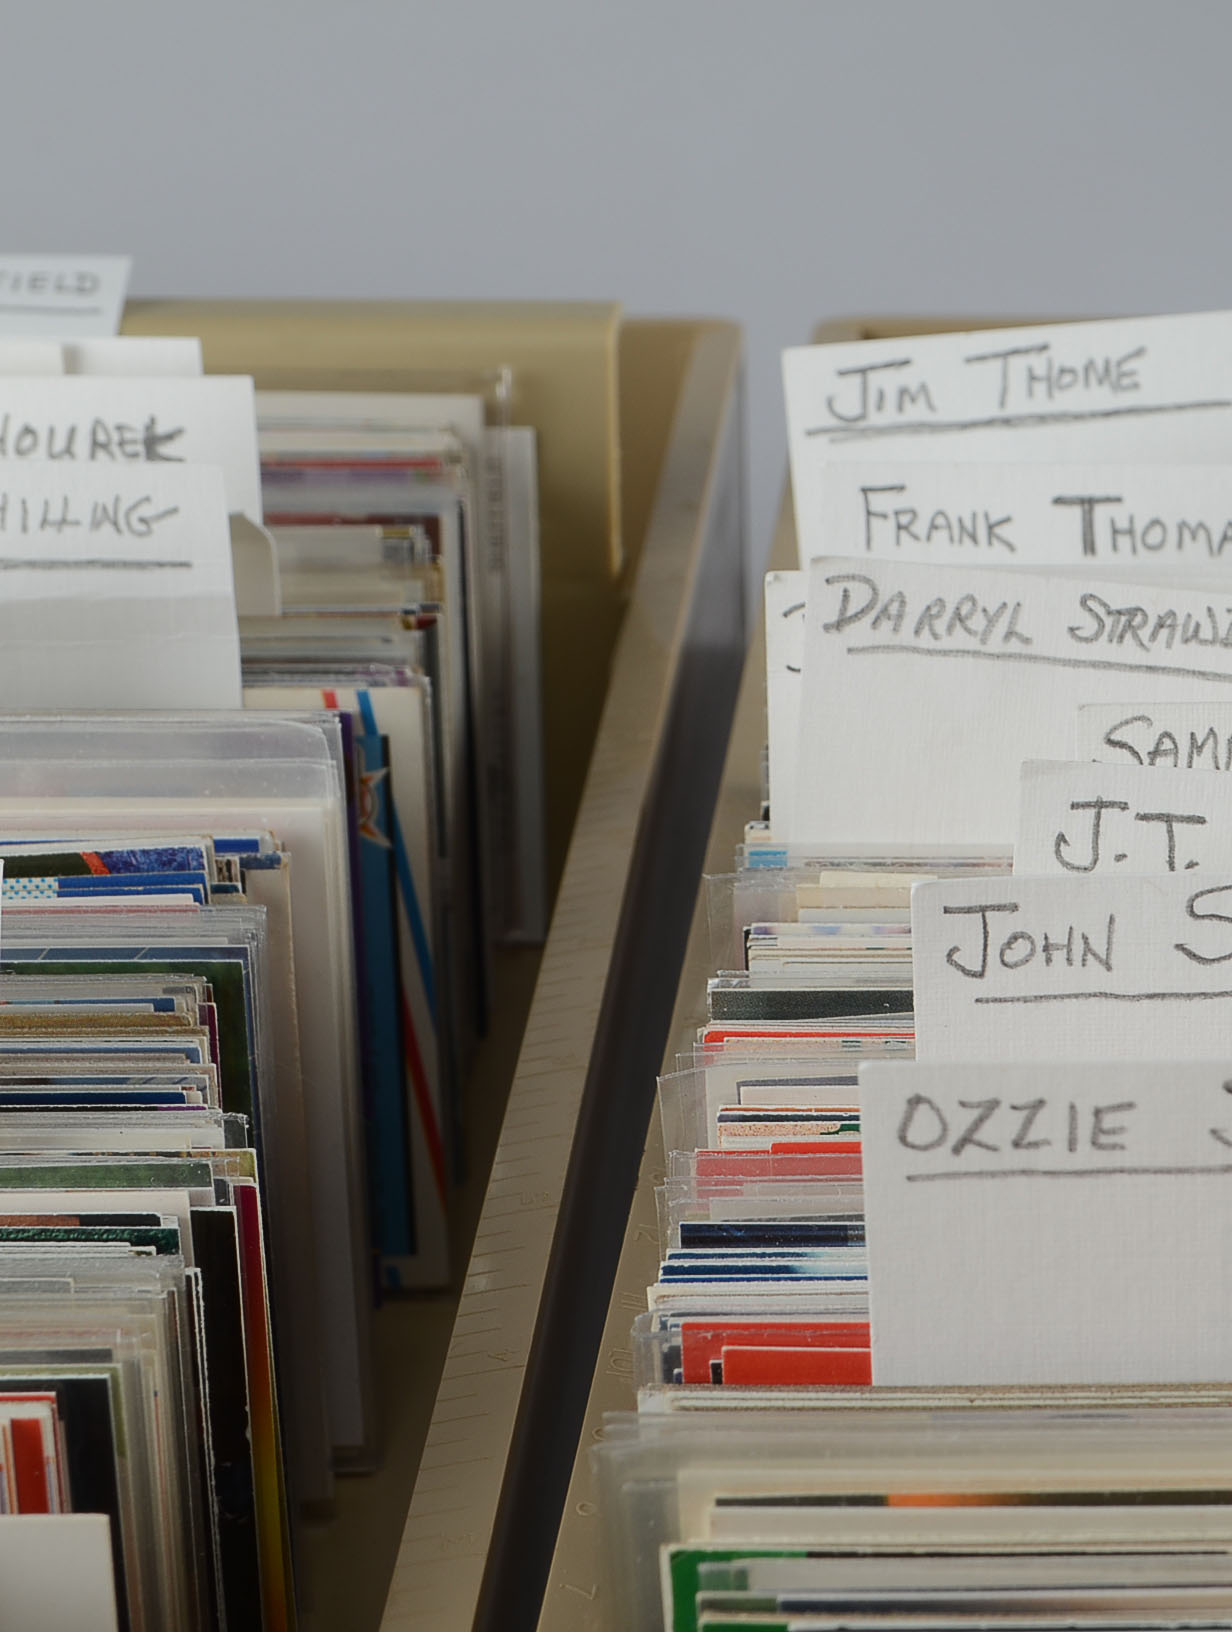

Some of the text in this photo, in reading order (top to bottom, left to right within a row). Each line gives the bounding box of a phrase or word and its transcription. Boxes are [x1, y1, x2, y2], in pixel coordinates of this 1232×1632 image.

[827, 344, 1147, 423] JIM THOME
[859, 485, 1017, 553] FRANK
[823, 574, 1032, 645] DARRYL
[1054, 795, 1208, 872] J.T.
[943, 902, 1116, 980] JOHN
[897, 1093, 1137, 1157] OZZIE
